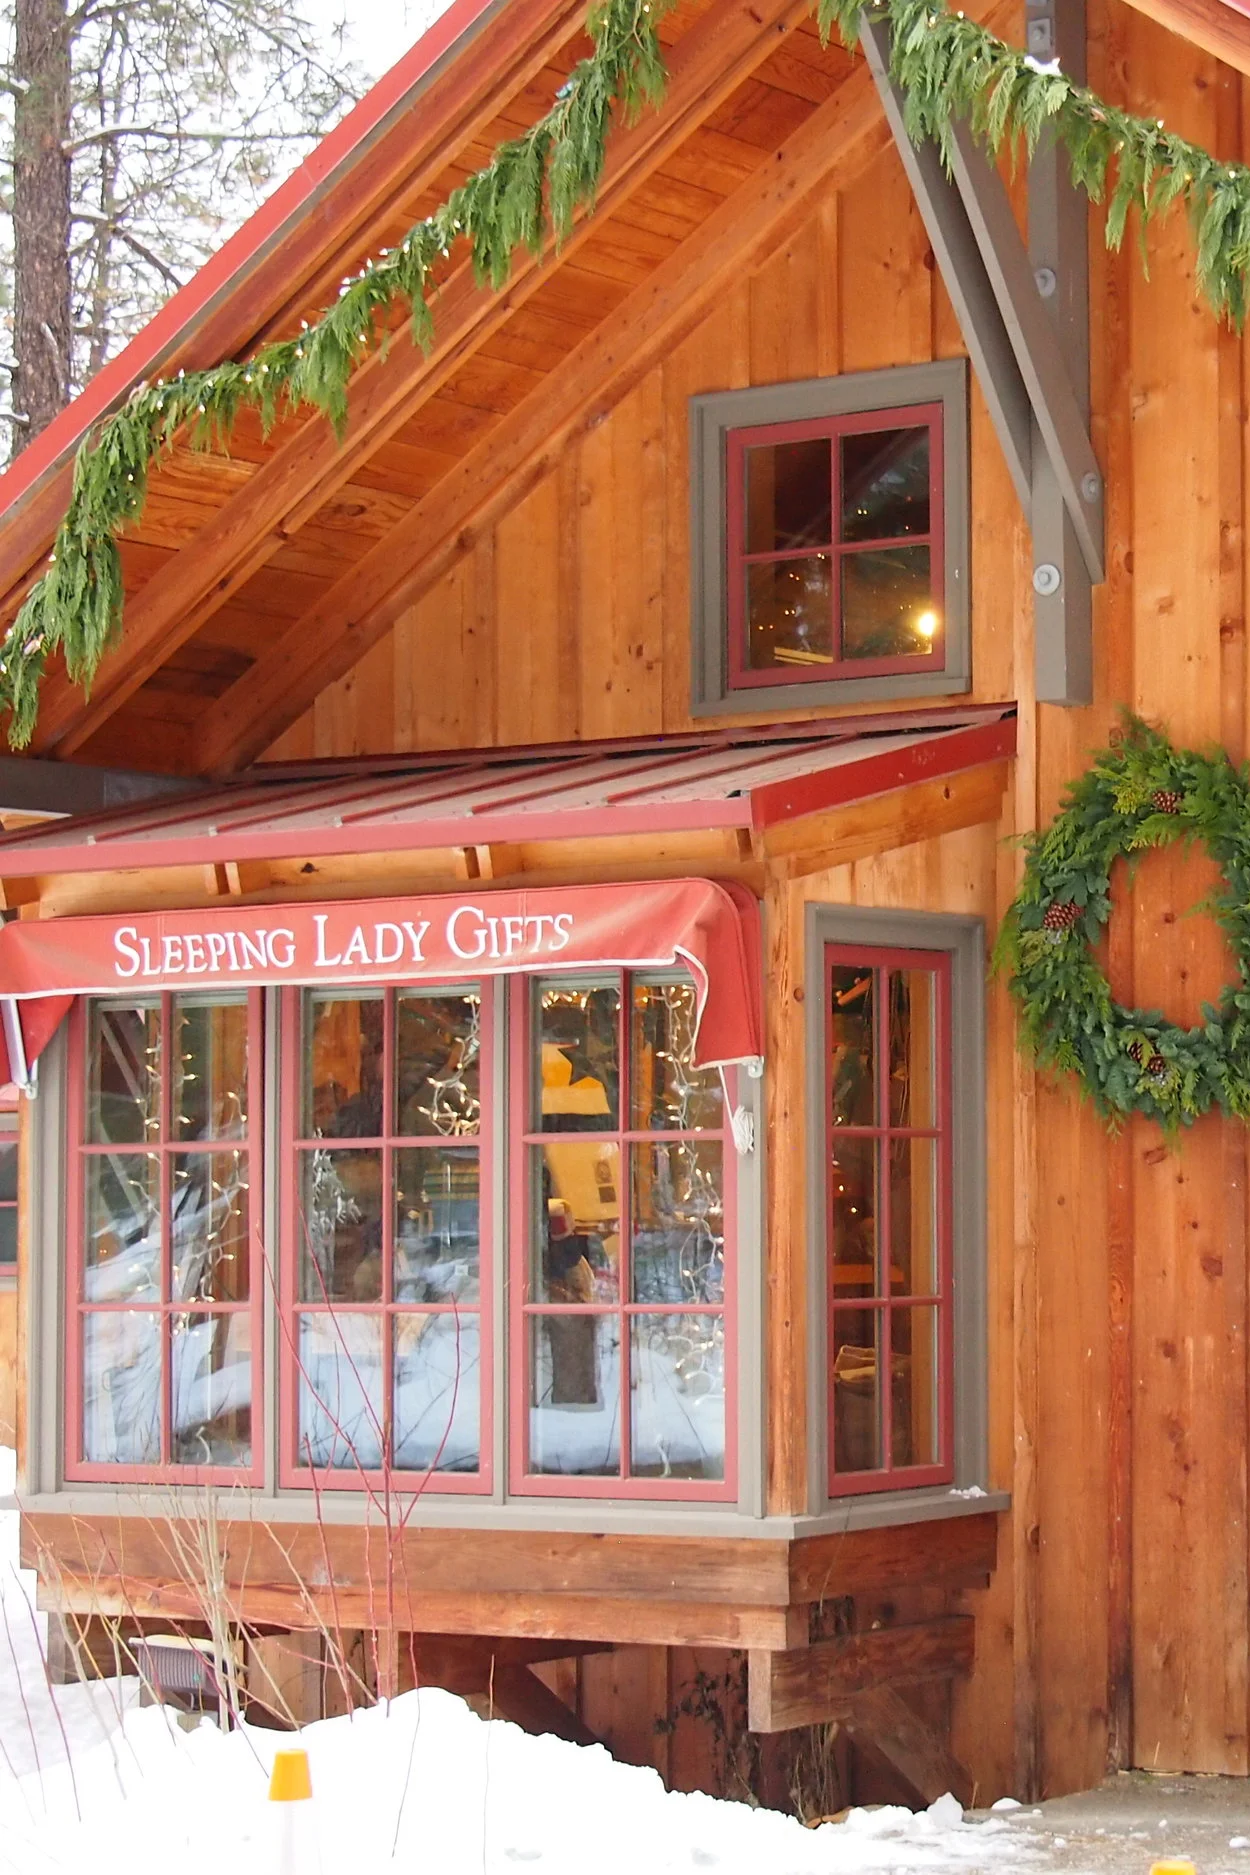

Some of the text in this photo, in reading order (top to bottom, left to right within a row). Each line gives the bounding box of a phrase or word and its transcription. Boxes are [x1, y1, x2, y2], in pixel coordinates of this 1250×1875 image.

[113, 905, 575, 978] SLEEPING LADY GIFTS
